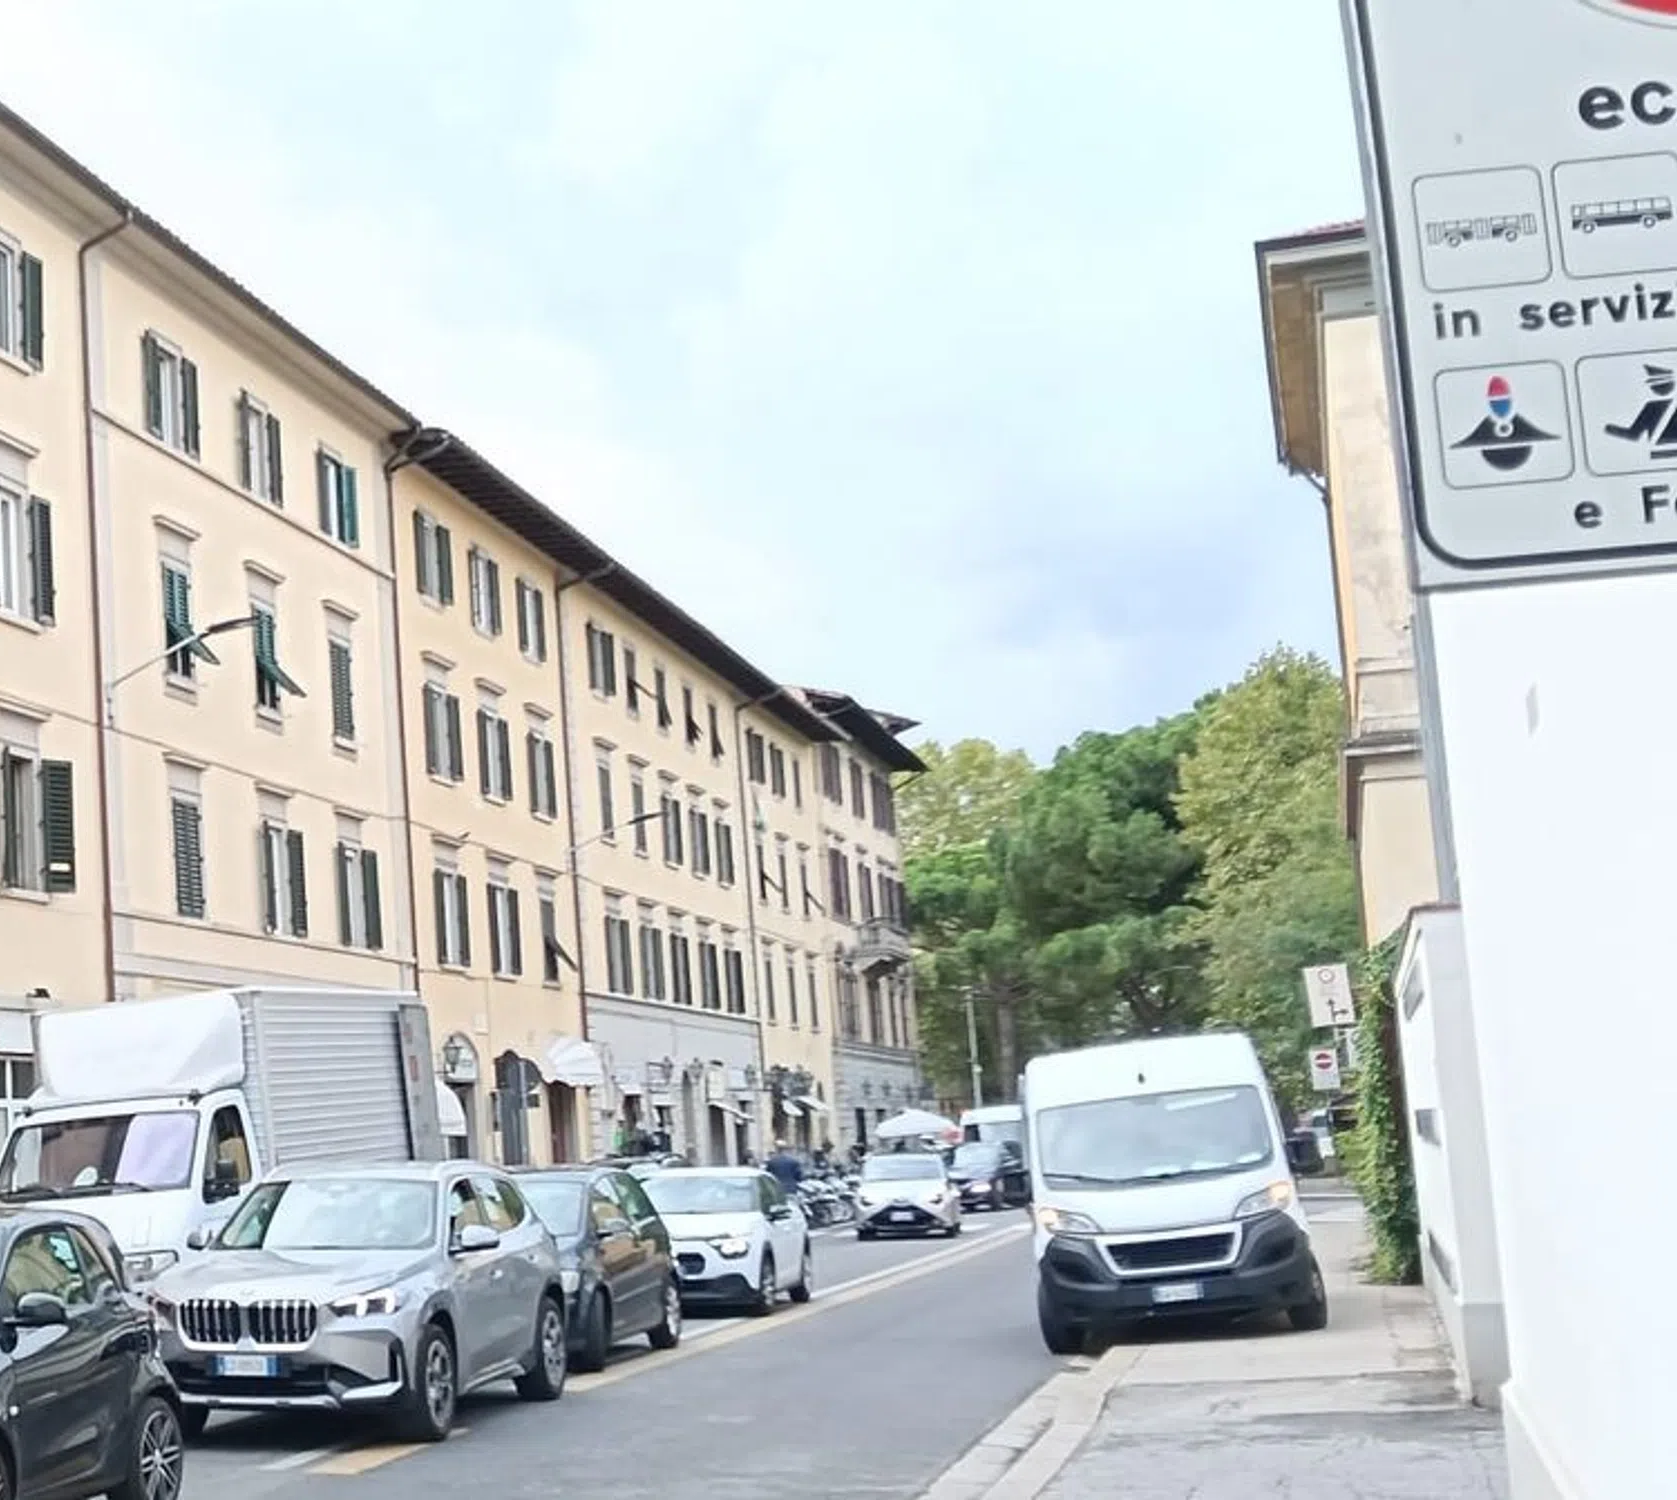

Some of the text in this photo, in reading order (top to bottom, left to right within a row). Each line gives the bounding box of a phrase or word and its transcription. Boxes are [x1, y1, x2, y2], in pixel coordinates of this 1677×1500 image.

[1578, 81, 1677, 130] ec
[1433, 282, 1676, 341] in serviz
[1573, 484, 1677, 529] e F
